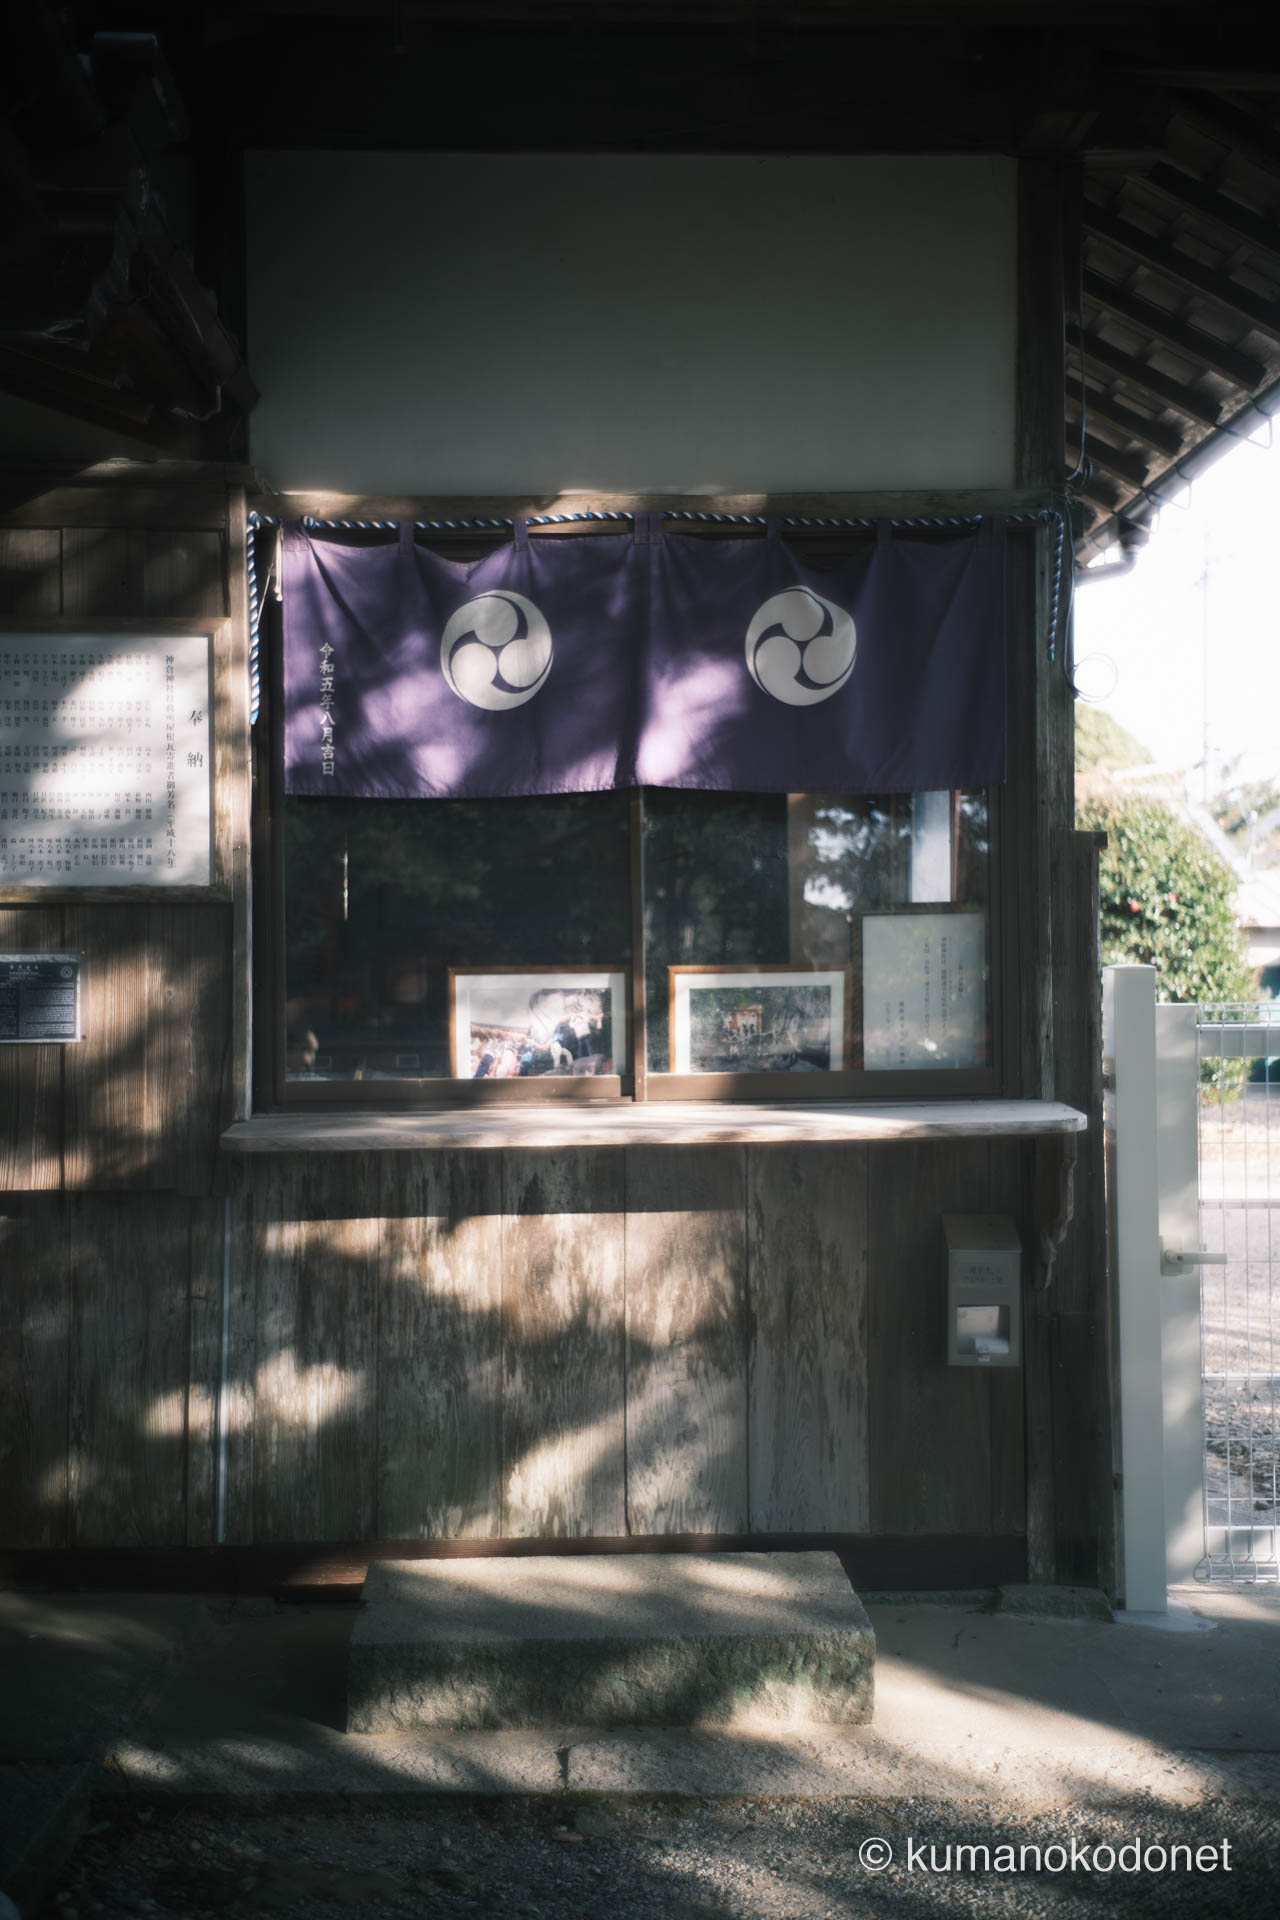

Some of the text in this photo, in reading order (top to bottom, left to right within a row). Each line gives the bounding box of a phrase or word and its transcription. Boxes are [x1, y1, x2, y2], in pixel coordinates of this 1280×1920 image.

[187, 709, 204, 768] 奉納
[319, 641, 336, 777] 令和五年八月吉日
